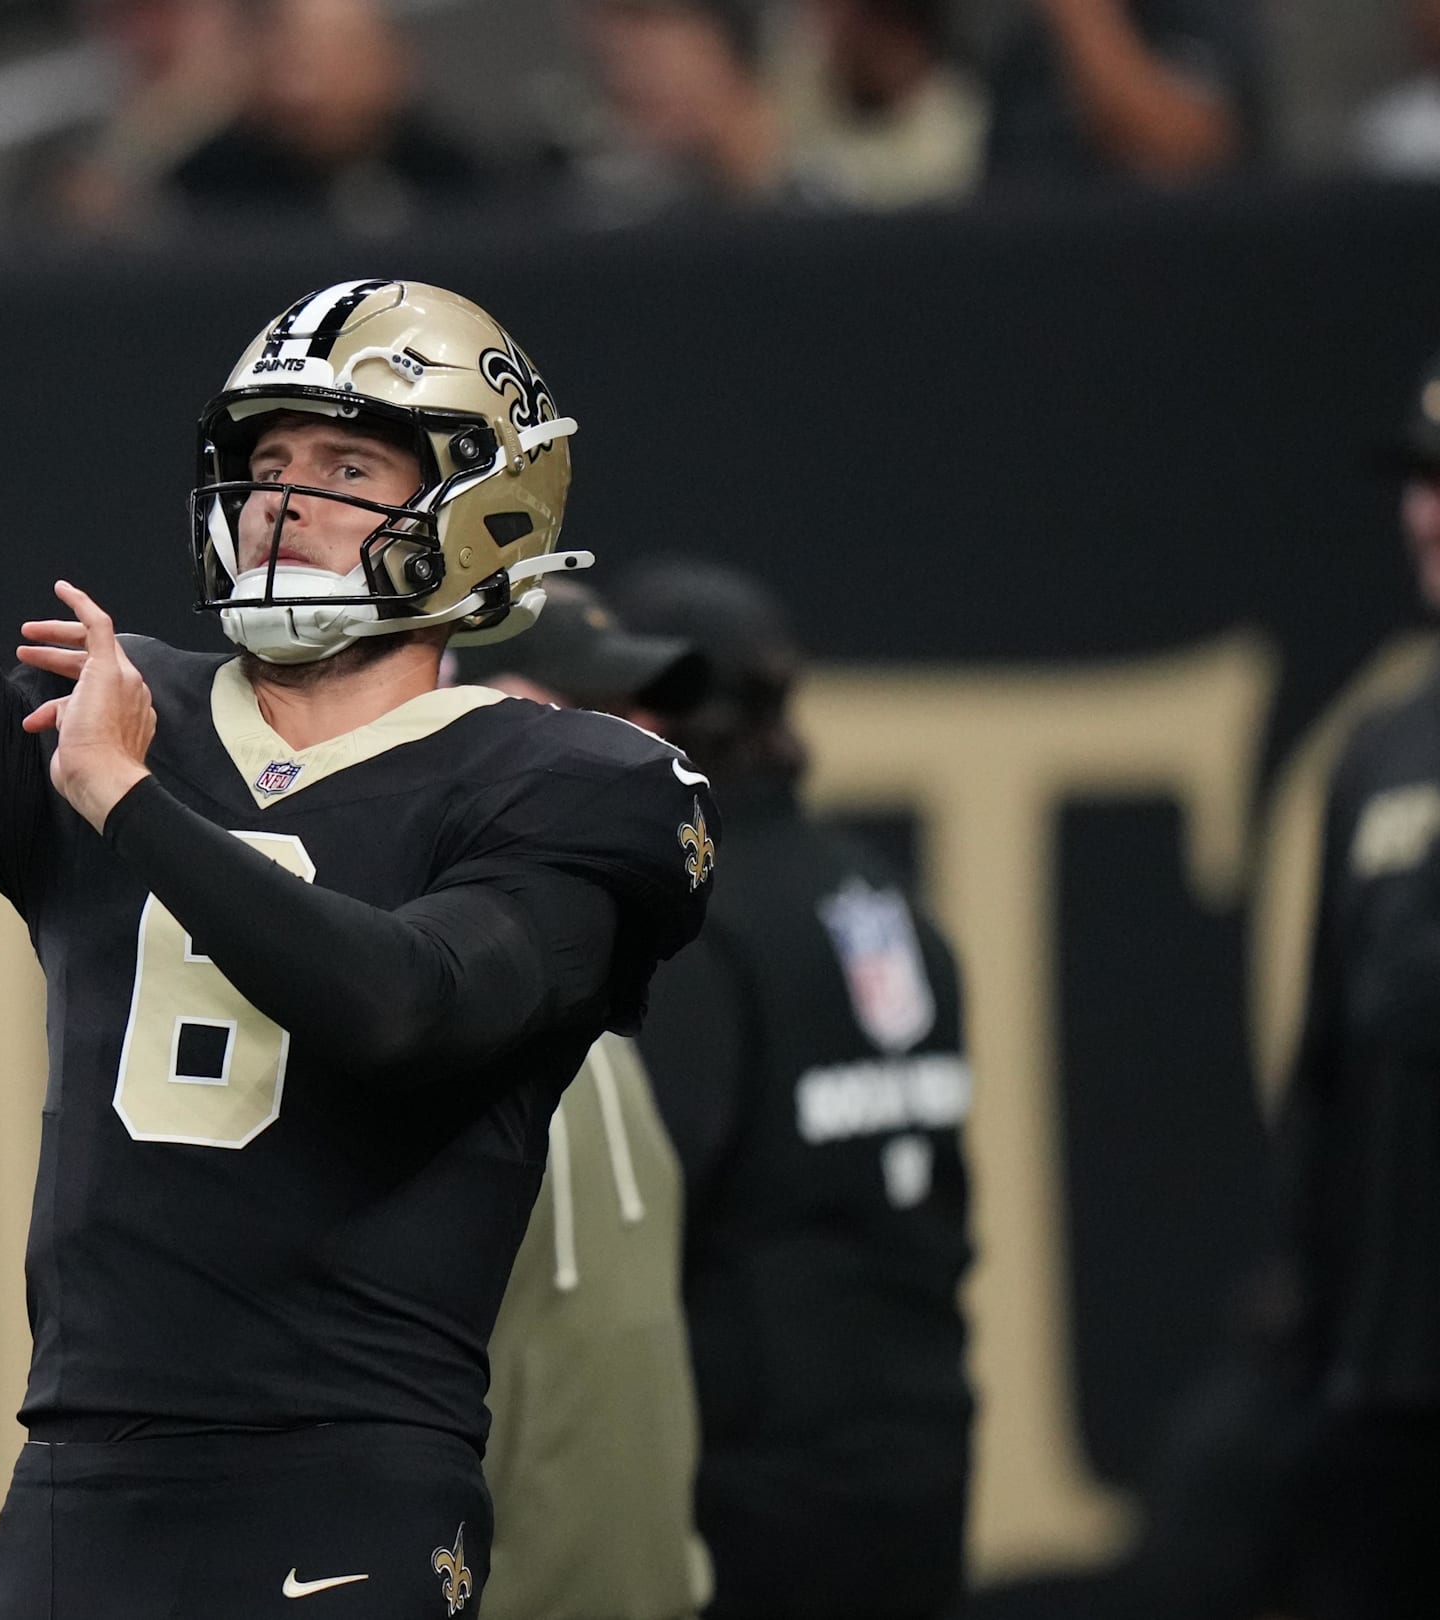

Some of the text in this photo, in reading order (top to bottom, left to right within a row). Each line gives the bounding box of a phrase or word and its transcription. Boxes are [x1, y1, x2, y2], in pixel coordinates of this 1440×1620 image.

[252, 358, 306, 374] SAINTS
[261, 773, 287, 789] NFL
[113, 831, 317, 1150] 6
